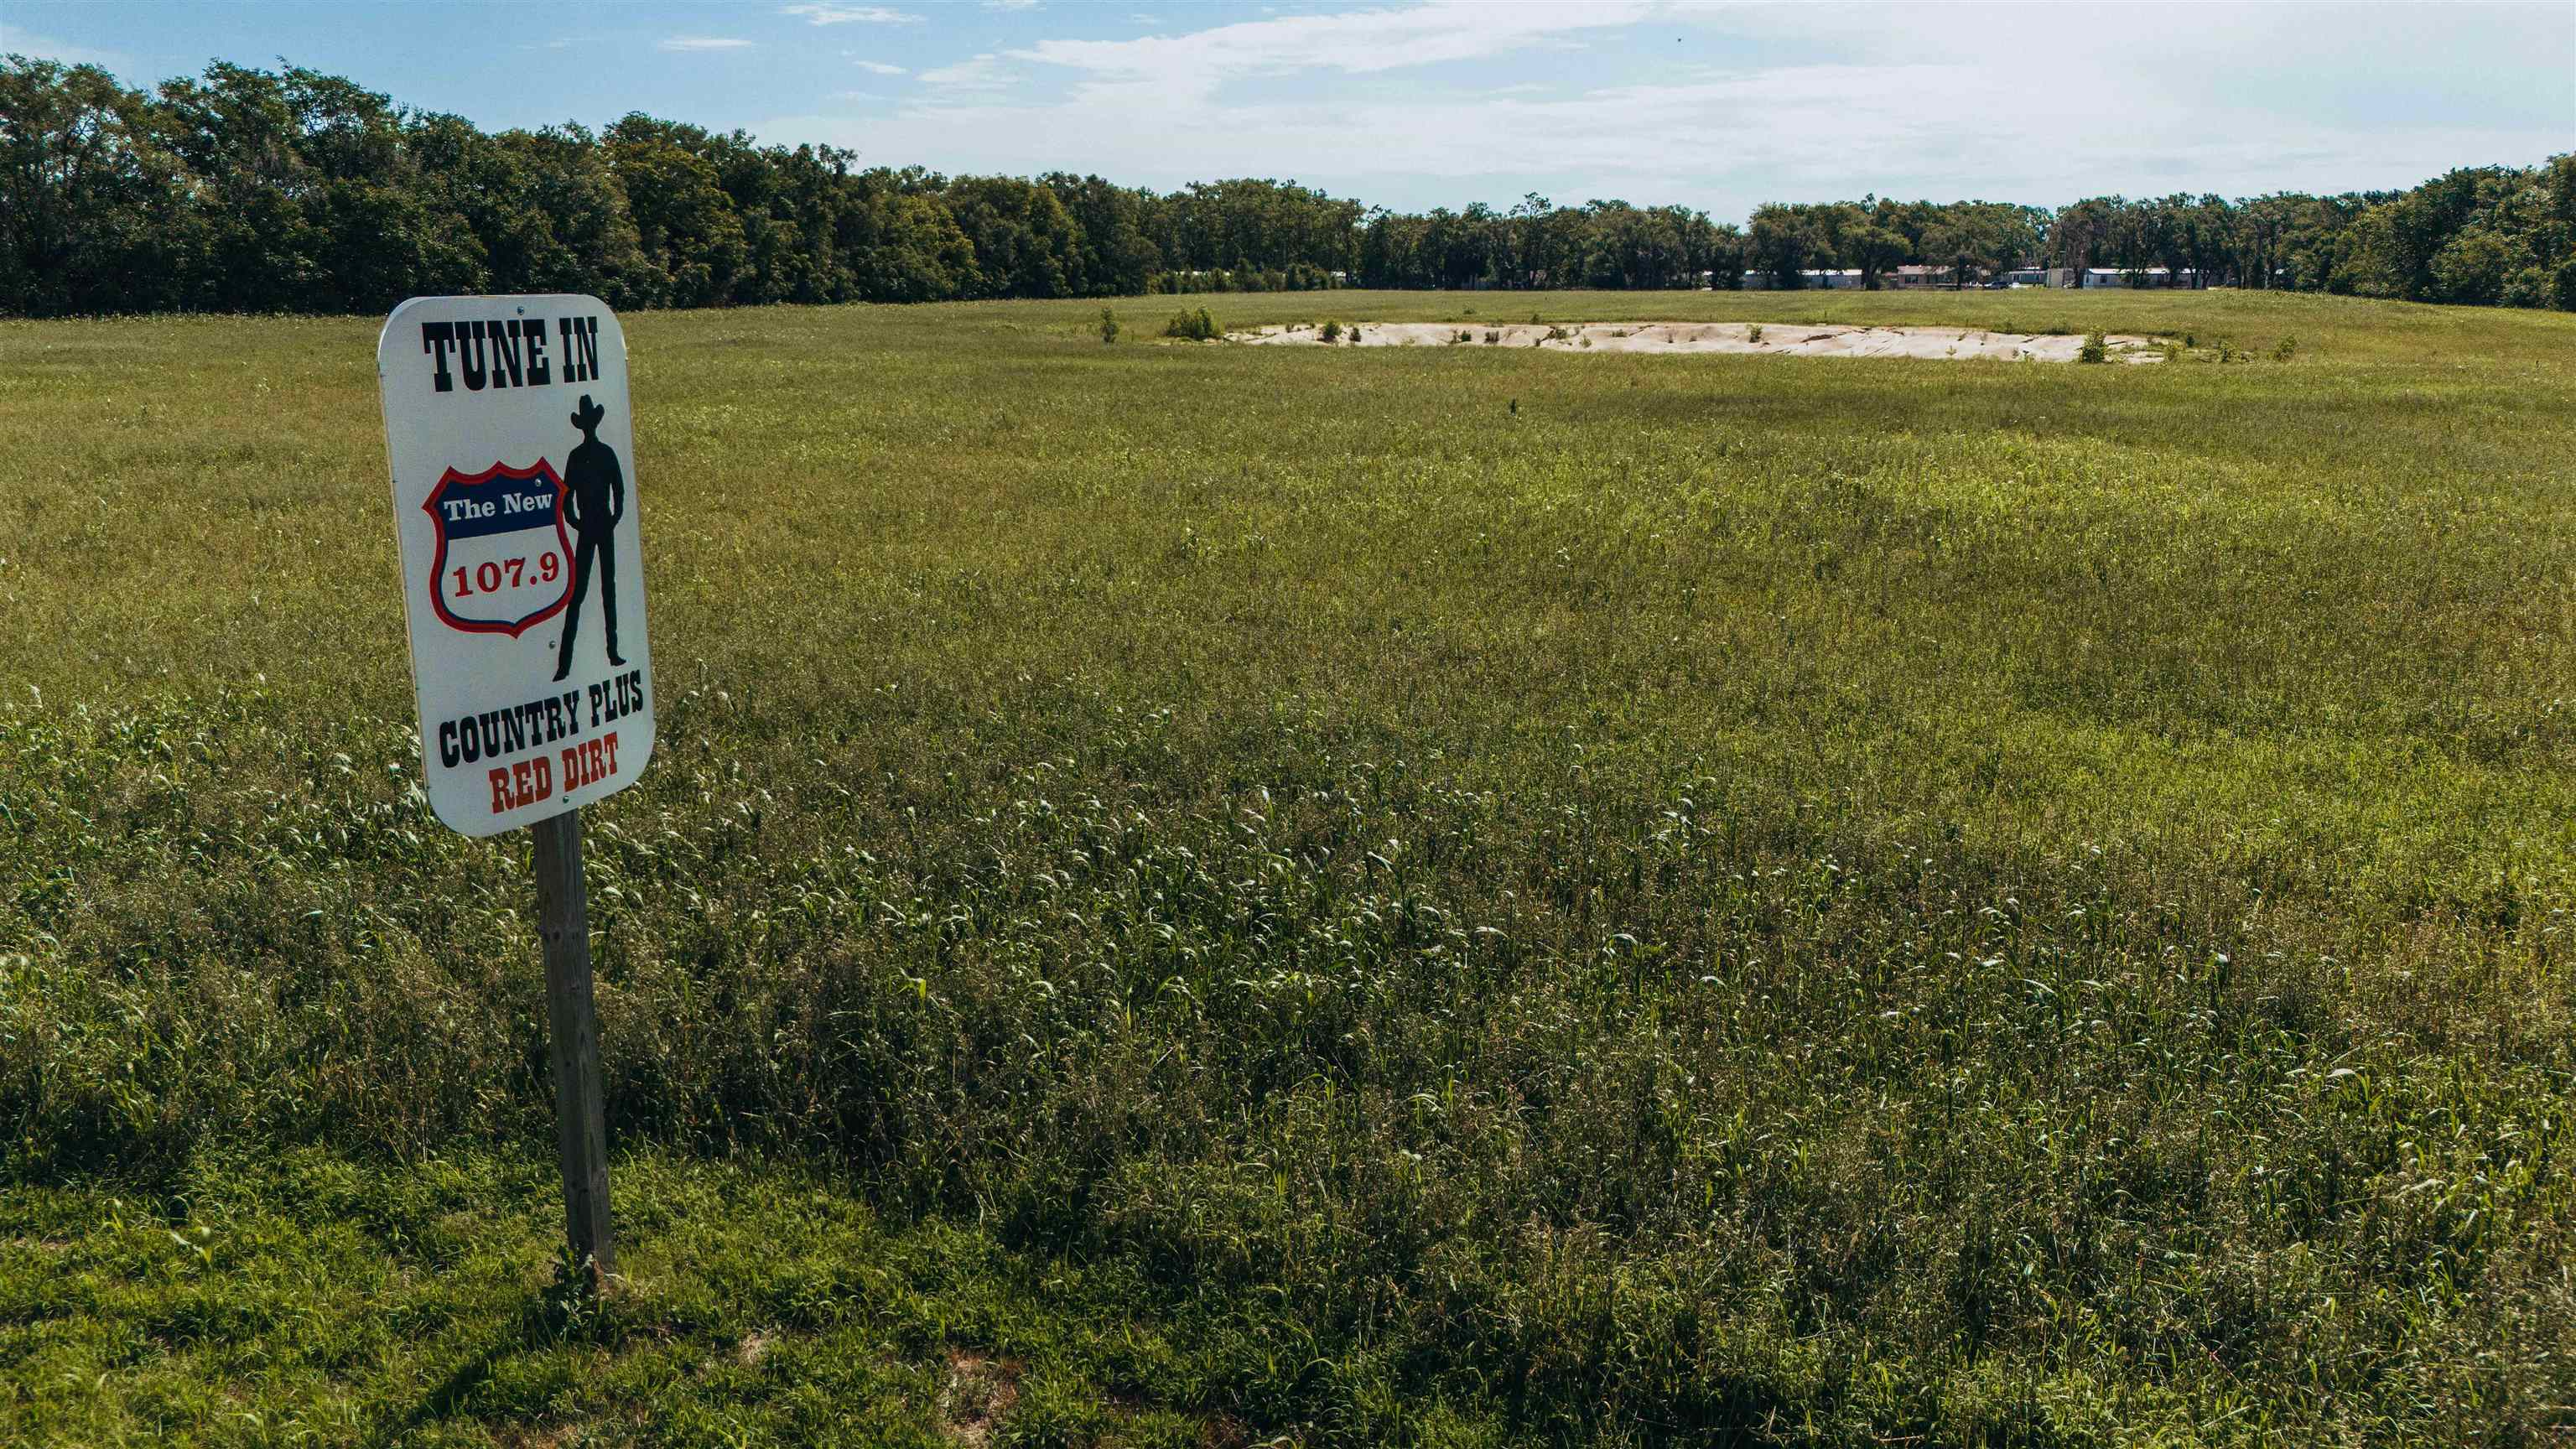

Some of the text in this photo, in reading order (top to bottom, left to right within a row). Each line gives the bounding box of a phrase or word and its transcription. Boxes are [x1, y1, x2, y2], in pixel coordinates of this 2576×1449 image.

[421, 315, 600, 392] TUNE IN
[444, 492, 553, 522] The New
[453, 551, 559, 598] 107.9
[439, 669, 644, 768] COUNTRY PLUS
[487, 731, 619, 814] RED DIRT
